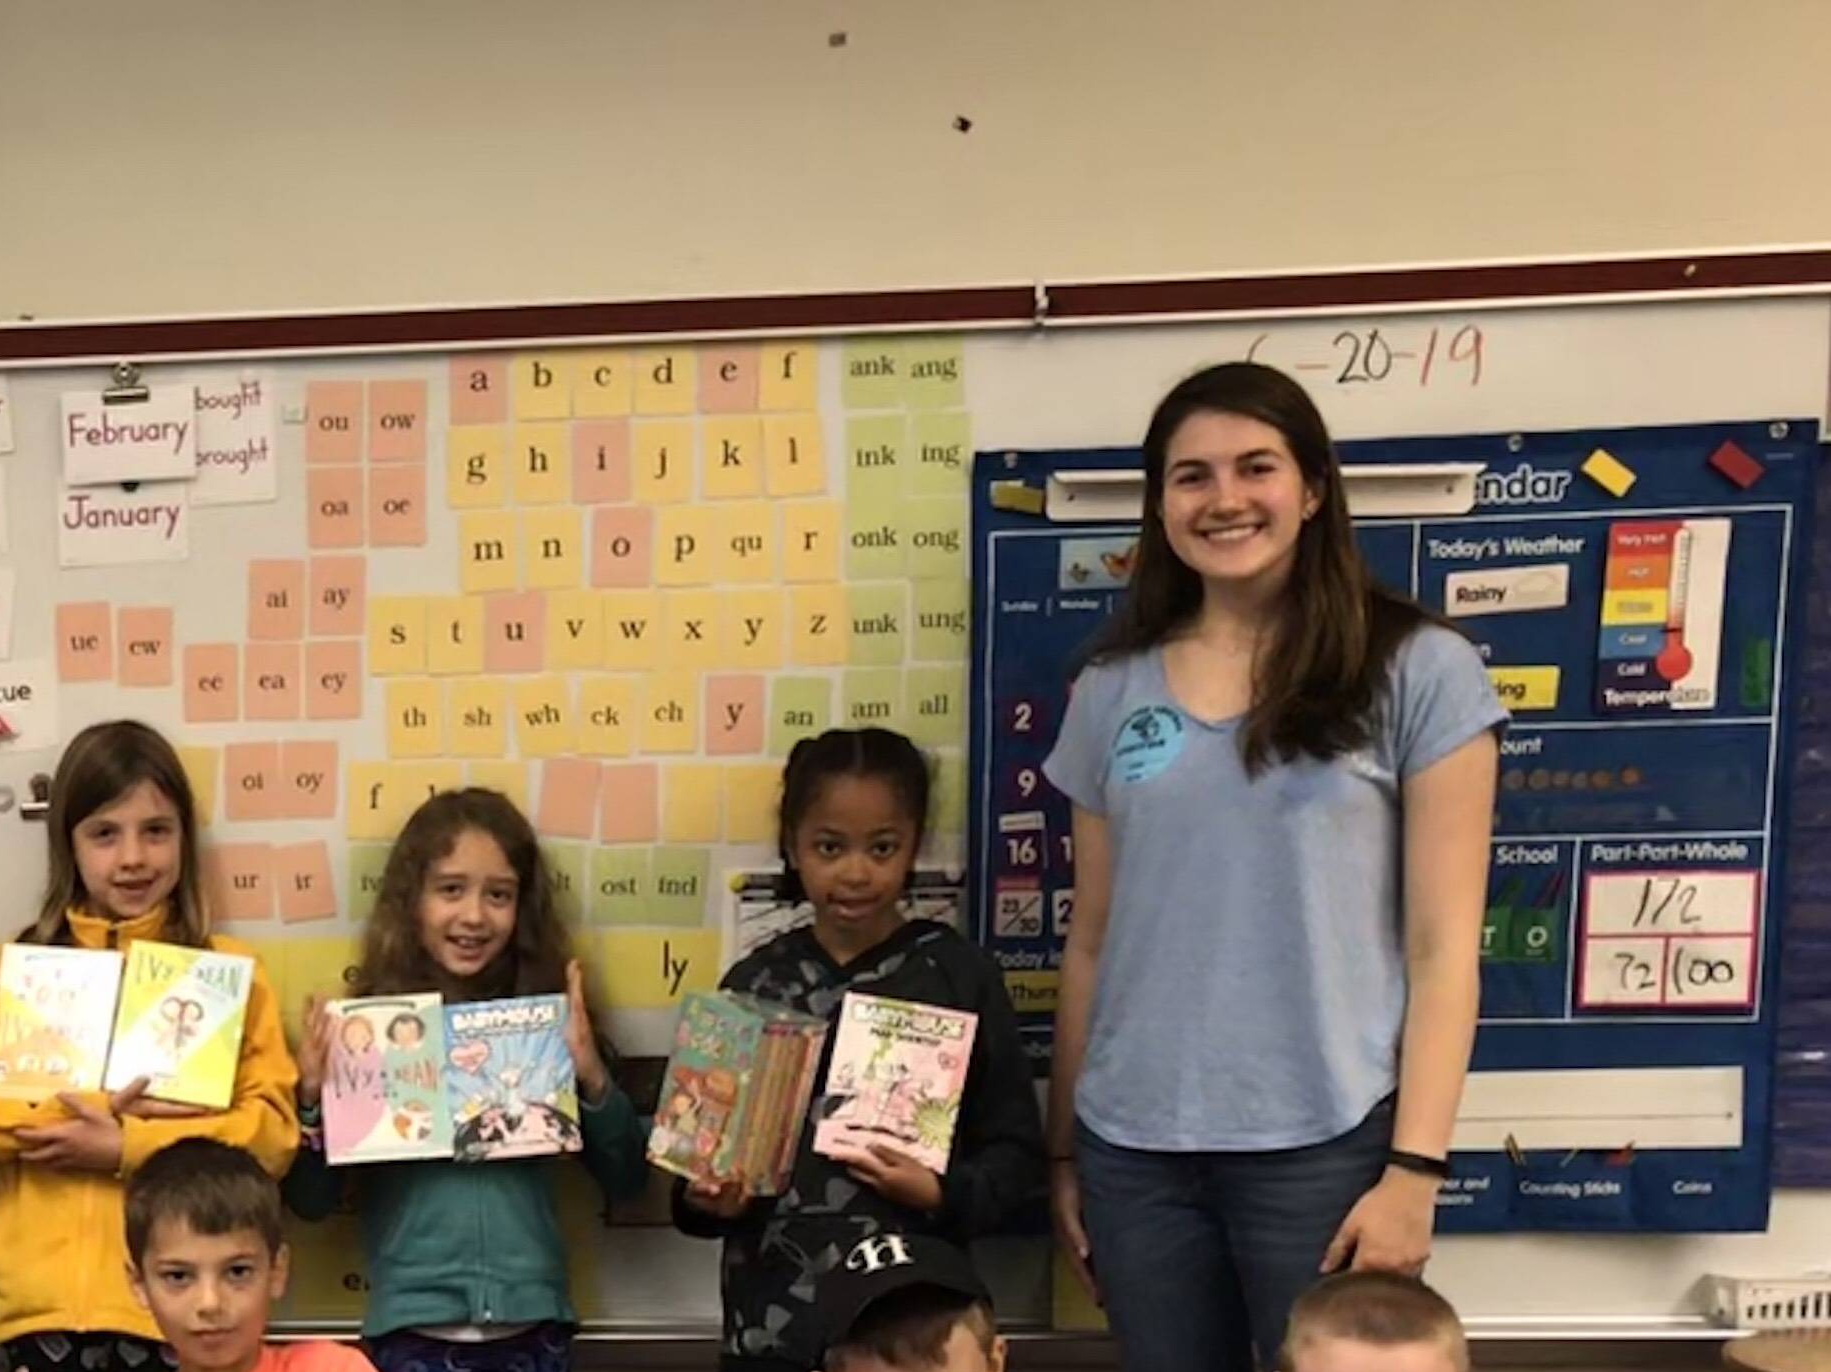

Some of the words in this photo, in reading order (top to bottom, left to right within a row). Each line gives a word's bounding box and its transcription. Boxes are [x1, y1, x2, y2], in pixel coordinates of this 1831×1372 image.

[470, 369, 489, 391] a
[533, 361, 553, 388] b
[594, 365, 612, 386] c
[652, 356, 674, 386] d
[719, 360, 739, 382] e
[781, 352, 798, 380] f
[849, 355, 896, 378] ank
[911, 356, 957, 382] ang
[194, 380, 262, 419] bought
[67, 413, 190, 455] February
[319, 411, 350, 432] ou
[380, 413, 414, 431] ow
[466, 452, 488, 484] g
[527, 445, 549, 473] h
[595, 444, 607, 470] i
[654, 447, 669, 479] j
[720, 439, 742, 467] k
[787, 436, 799, 464] l
[855, 444, 897, 468] ink
[921, 441, 962, 468] ing
[64, 495, 181, 540] January
[320, 499, 350, 518] oa
[383, 498, 410, 516] oe
[473, 538, 505, 561] m
[541, 536, 563, 558] n
[611, 537, 631, 558] o
[673, 534, 696, 562] p
[730, 533, 764, 557] qu
[801, 530, 819, 551] r
[850, 527, 898, 549] onk
[912, 529, 960, 554] ong
[1427, 538, 1500, 561] Today's
[1504, 536, 1585, 557] Weather
[265, 587, 289, 609] ai
[322, 585, 351, 609] ay
[1455, 584, 1508, 605] Rainy
[390, 625, 407, 645] s
[449, 620, 463, 643] t
[504, 621, 524, 642] u
[566, 618, 585, 639] v
[619, 619, 647, 640] w
[684, 619, 705, 640] x
[743, 616, 764, 646] y
[808, 614, 827, 635] z
[852, 613, 898, 635] unk
[919, 608, 967, 635] ung
[70, 632, 100, 652] ue
[128, 638, 161, 656] ew
[198, 674, 225, 691] ee
[258, 672, 286, 690] ea
[320, 671, 348, 693] ey
[402, 707, 428, 728] th
[463, 706, 492, 727] sh
[525, 703, 562, 727] wh
[590, 704, 620, 726] ck
[654, 701, 684, 723] ch
[725, 700, 745, 730] y
[783, 710, 815, 727] an
[851, 700, 891, 719] am
[918, 695, 949, 716] all
[1013, 702, 1033, 731] 2
[1500, 736, 1543, 754] ount
[242, 771, 265, 792] oi
[295, 770, 325, 794] oy
[1018, 768, 1036, 797] 9
[369, 783, 383, 810] f
[1007, 836, 1038, 867] 16
[1496, 843, 1559, 864] School
[1590, 842, 1749, 863] Part-Part-Whole
[233, 871, 260, 890] ur
[294, 871, 314, 891] ir
[601, 877, 637, 896] ost
[662, 940, 689, 996] ly
